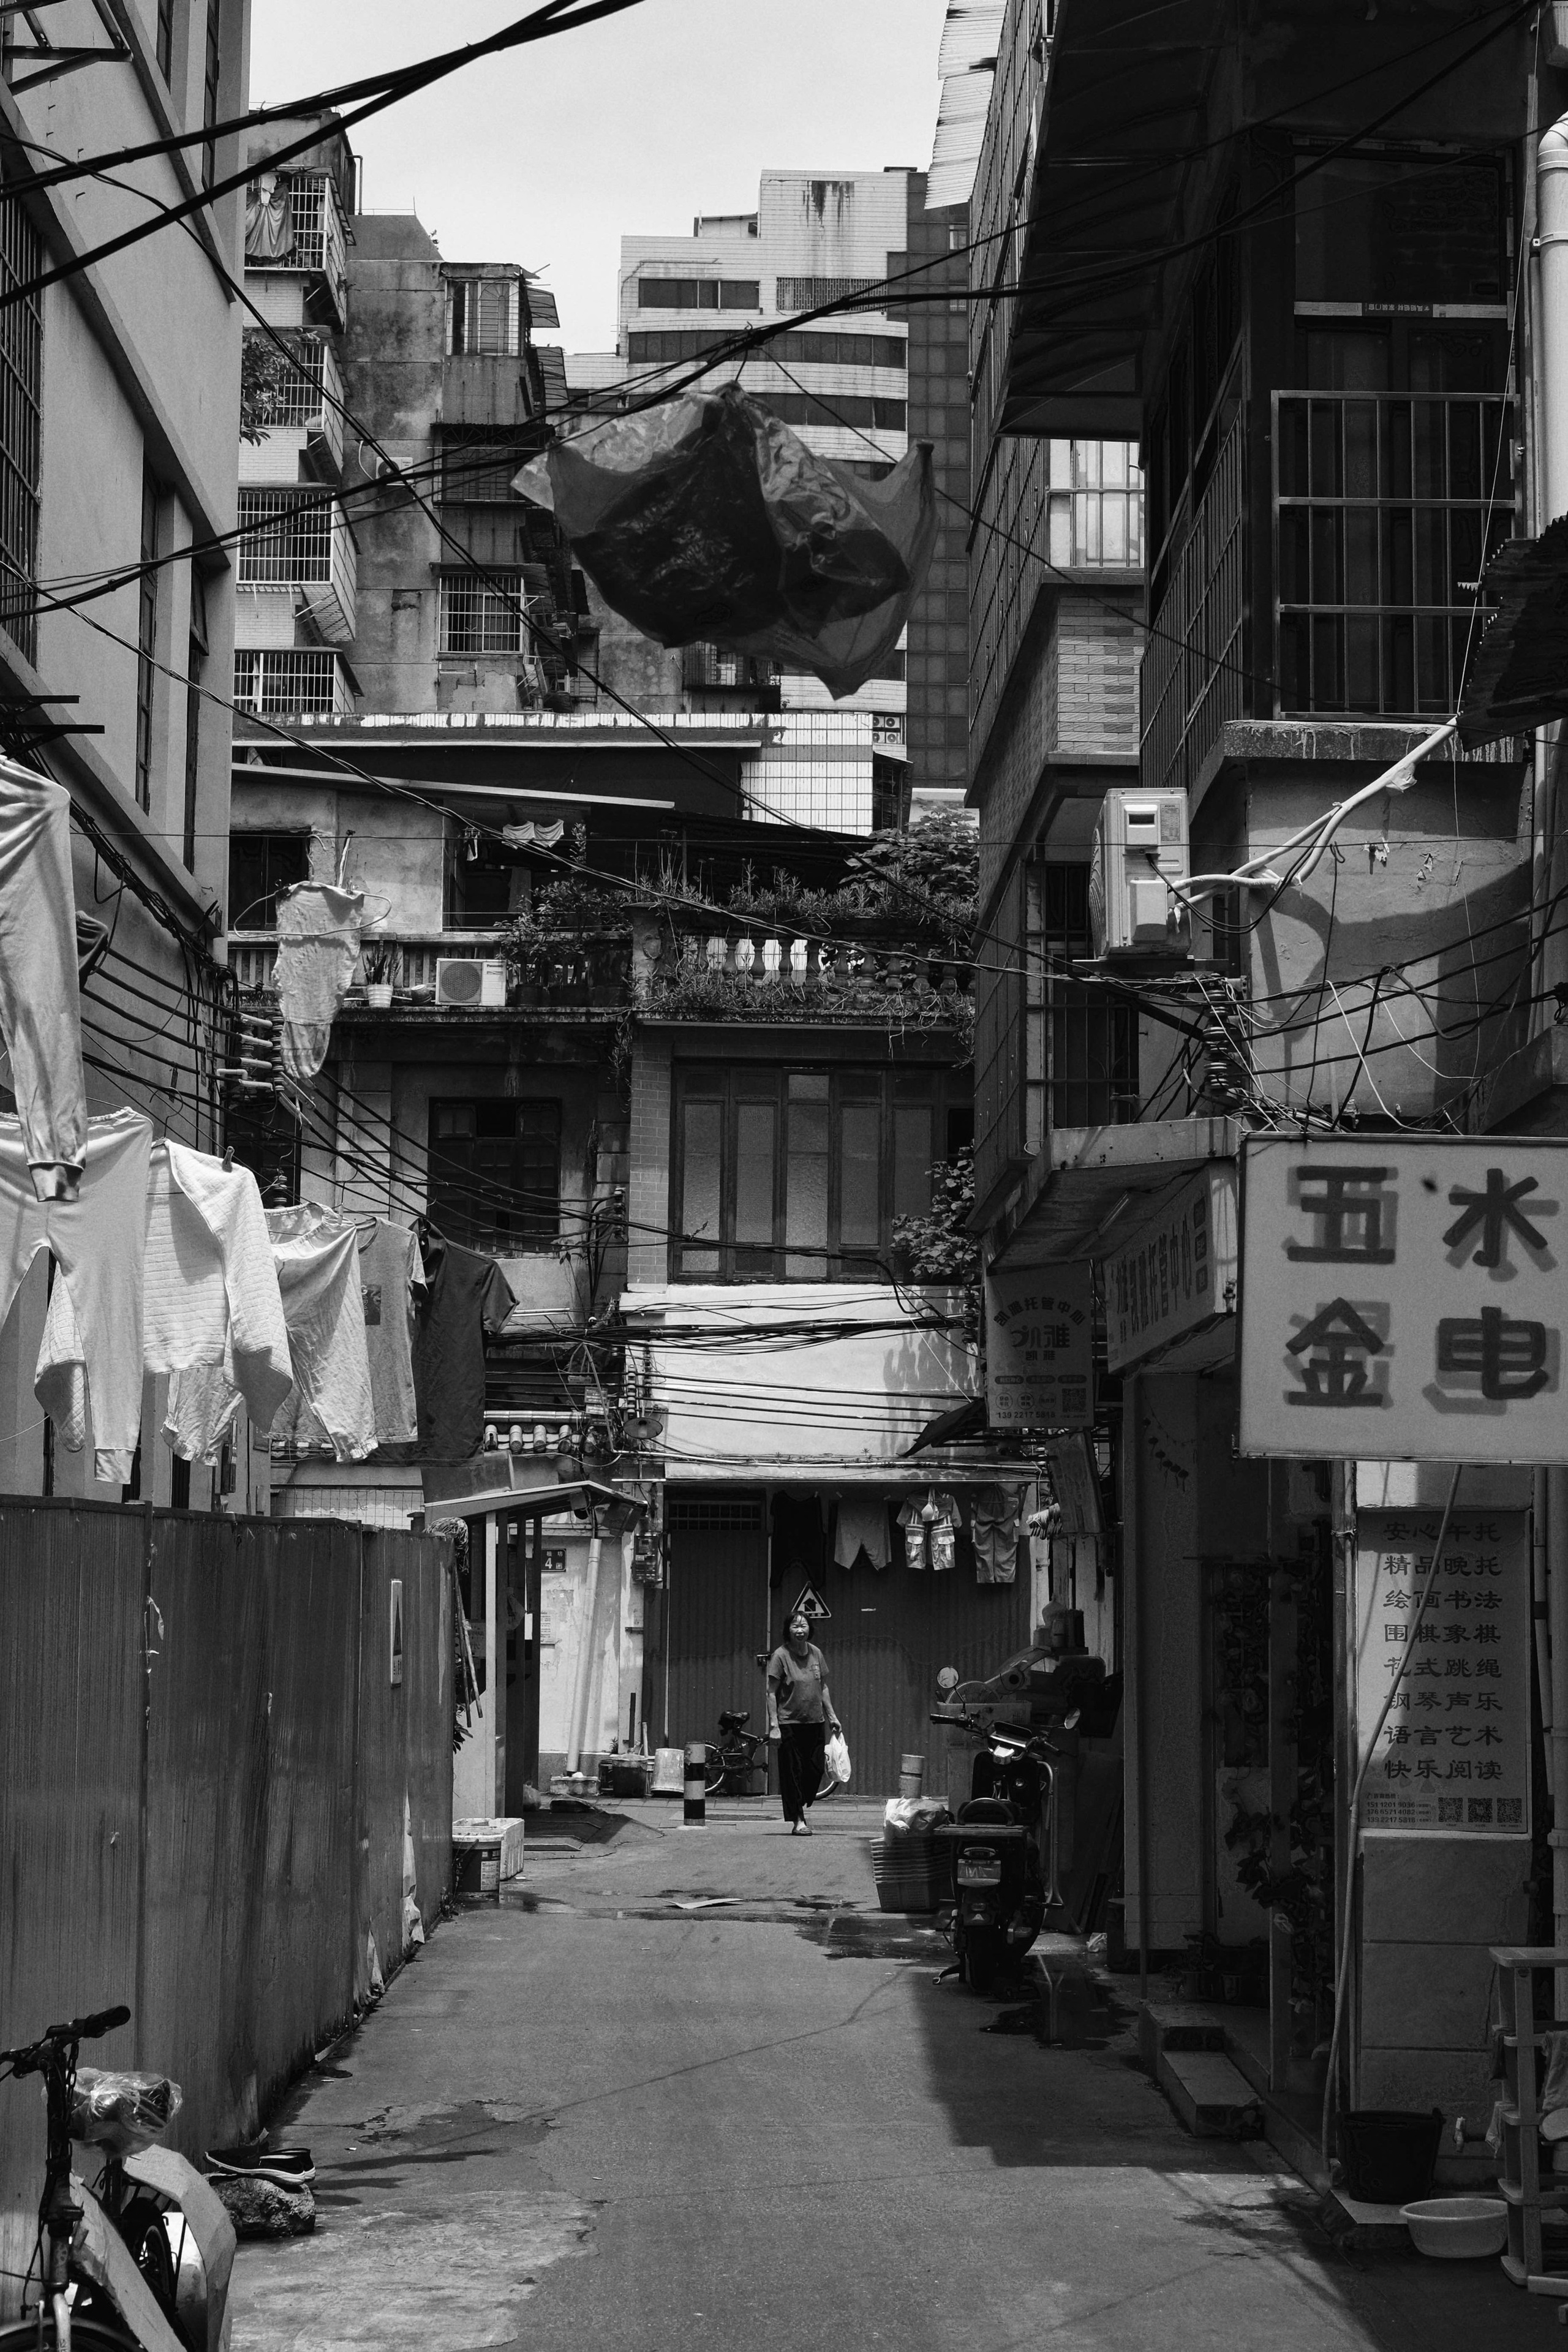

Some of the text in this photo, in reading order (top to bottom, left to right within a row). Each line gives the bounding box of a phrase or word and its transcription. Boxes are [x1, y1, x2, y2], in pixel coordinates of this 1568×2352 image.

[1383, 1521, 1501, 1542] 安心午托
[545, 1557, 552, 1569] 4
[1383, 1555, 1502, 1577] 精品晚托
[1383, 1589, 1503, 1610] 绘画书法
[1384, 1624, 1501, 1644] 围棋象棋
[1384, 1657, 1502, 1678] 花式跳绳
[1384, 1691, 1504, 1712] 钢琴声乐
[1384, 1725, 1504, 1747] 语言艺术
[1384, 1759, 1504, 1781] 快乐阅读
